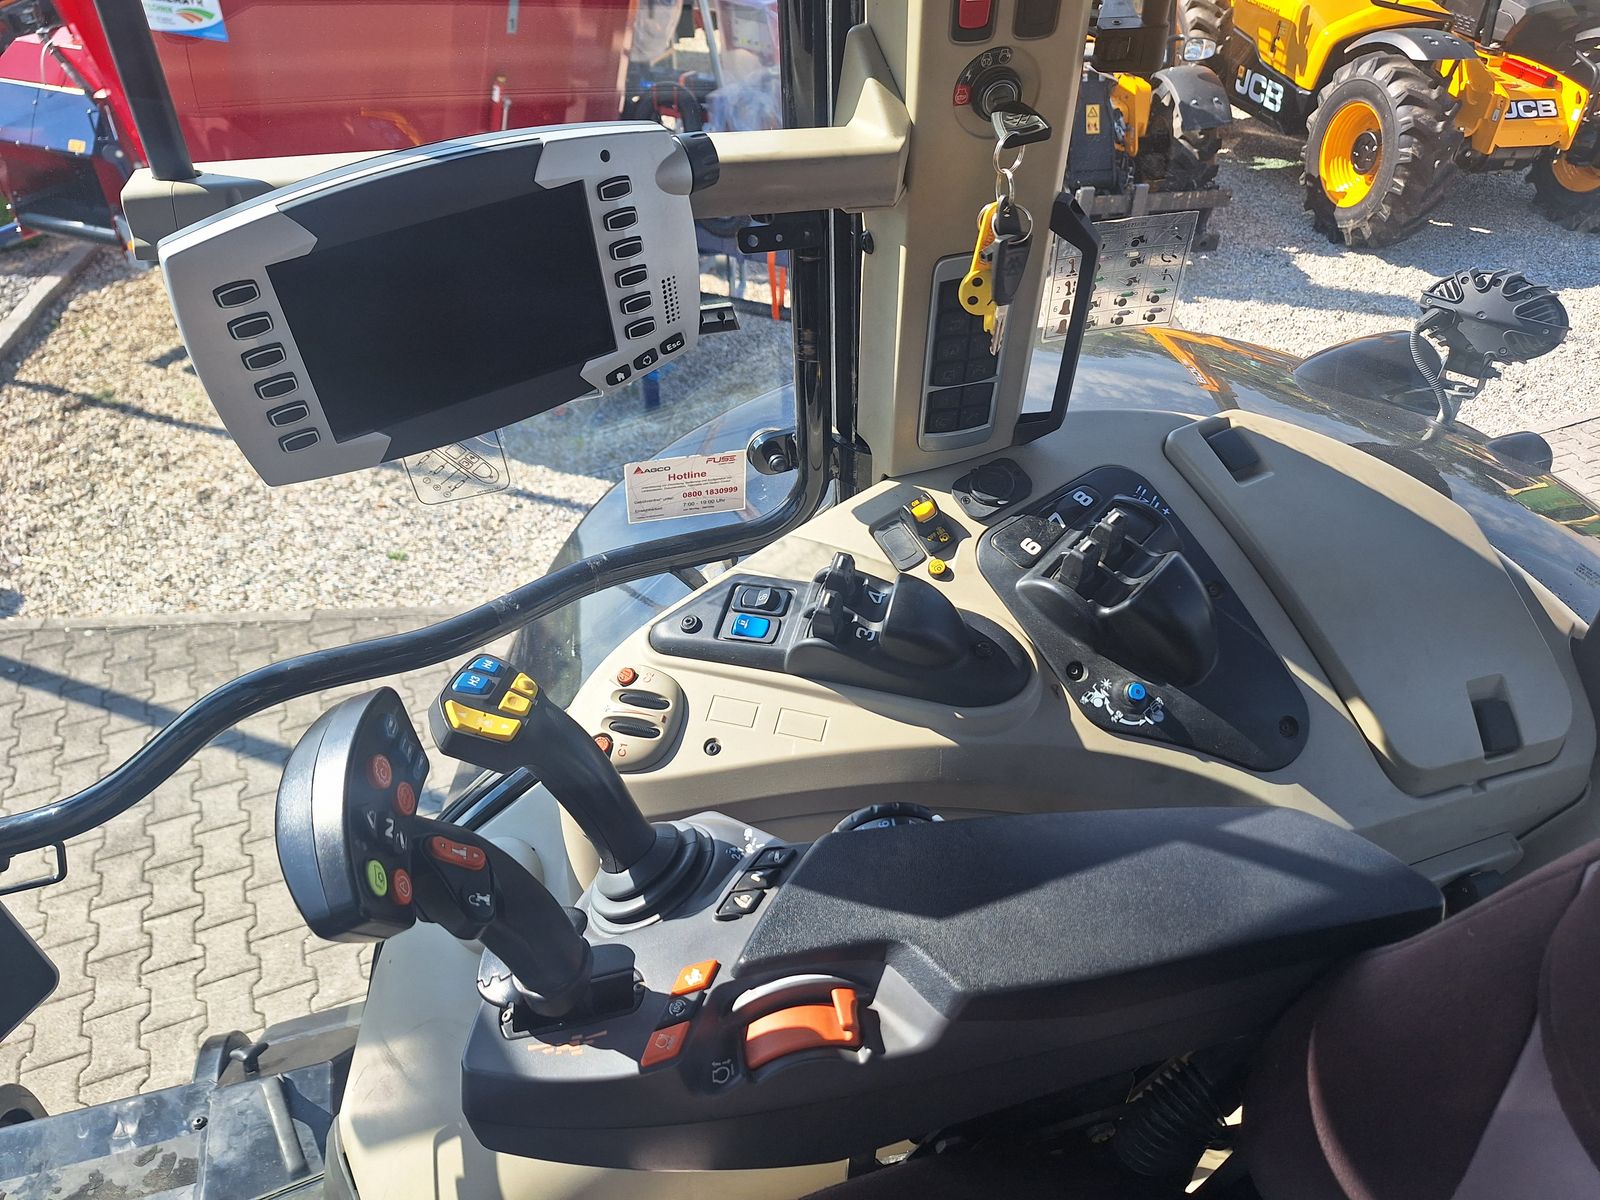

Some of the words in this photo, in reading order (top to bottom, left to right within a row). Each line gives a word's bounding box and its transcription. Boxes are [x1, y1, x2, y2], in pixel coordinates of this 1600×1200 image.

[1235, 68, 1284, 113] JCB
[1504, 100, 1558, 119] JCB
[666, 340, 682, 351] Esc
[643, 466, 671, 474] AGCO
[668, 470, 707, 482] Hotline
[682, 490, 703, 499] 0800
[705, 486, 738, 497] 1830999
[1072, 490, 1094, 507] 8
[1048, 511, 1066, 529] 7
[1019, 537, 1042, 556] 6
[868, 590, 888, 605] 4
[855, 626, 876, 641] 3
[481, 659, 494, 669] H4
[467, 675, 480, 687] H3
[617, 743, 628, 757] C1
